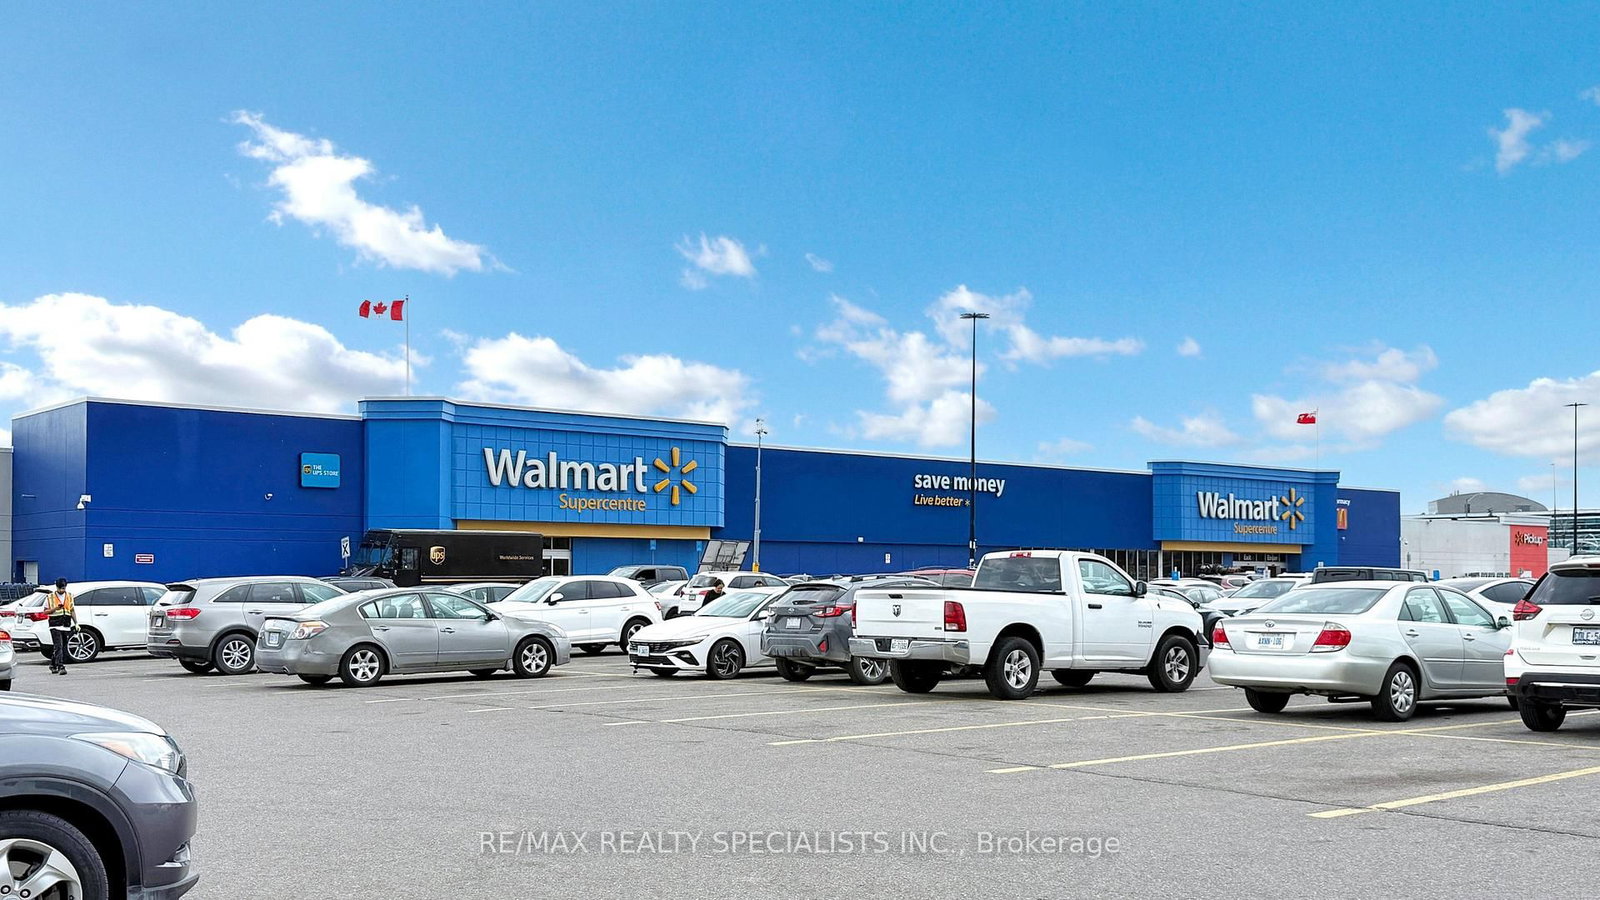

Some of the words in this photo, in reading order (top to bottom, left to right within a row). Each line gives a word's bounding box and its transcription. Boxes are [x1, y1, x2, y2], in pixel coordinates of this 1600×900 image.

[483, 447, 648, 493] Walmart
[914, 473, 950, 490] save
[953, 475, 1006, 498] money
[559, 493, 647, 512] Supercentre
[914, 493, 934, 506] Live
[934, 494, 964, 507] better
[1197, 491, 1280, 521] Walmart
[1233, 521, 1278, 536] Supercentre
[1523, 533, 1543, 546] Pickup
